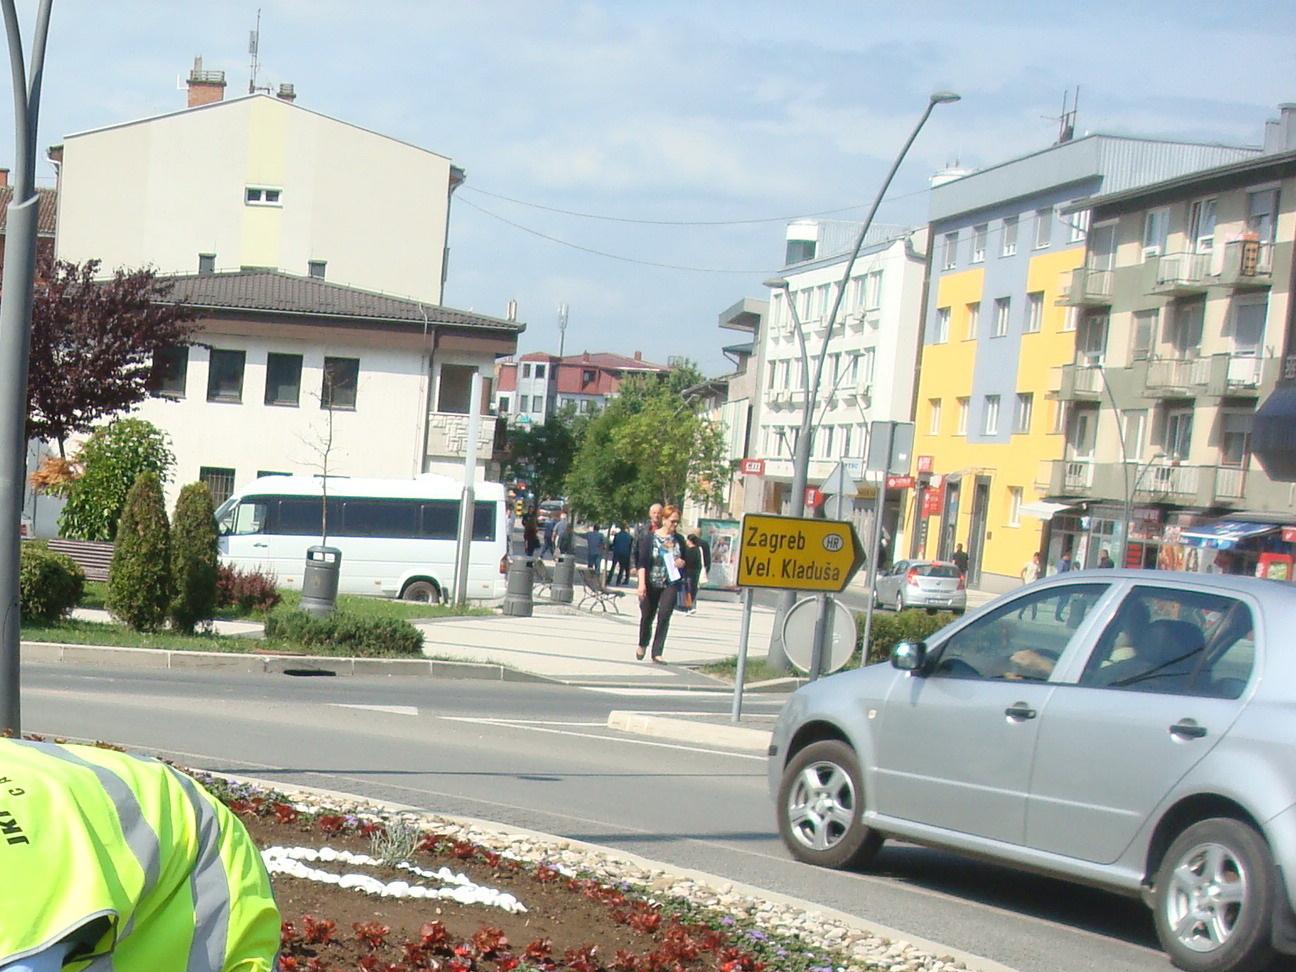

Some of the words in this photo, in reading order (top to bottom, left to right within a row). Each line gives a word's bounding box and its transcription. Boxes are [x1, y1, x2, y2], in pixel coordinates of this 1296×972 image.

[747, 527, 805, 553] Zagreb
[826, 537, 840, 549] HR
[745, 556, 775, 577] Vel.
[781, 558, 840, 581] Kladuša
